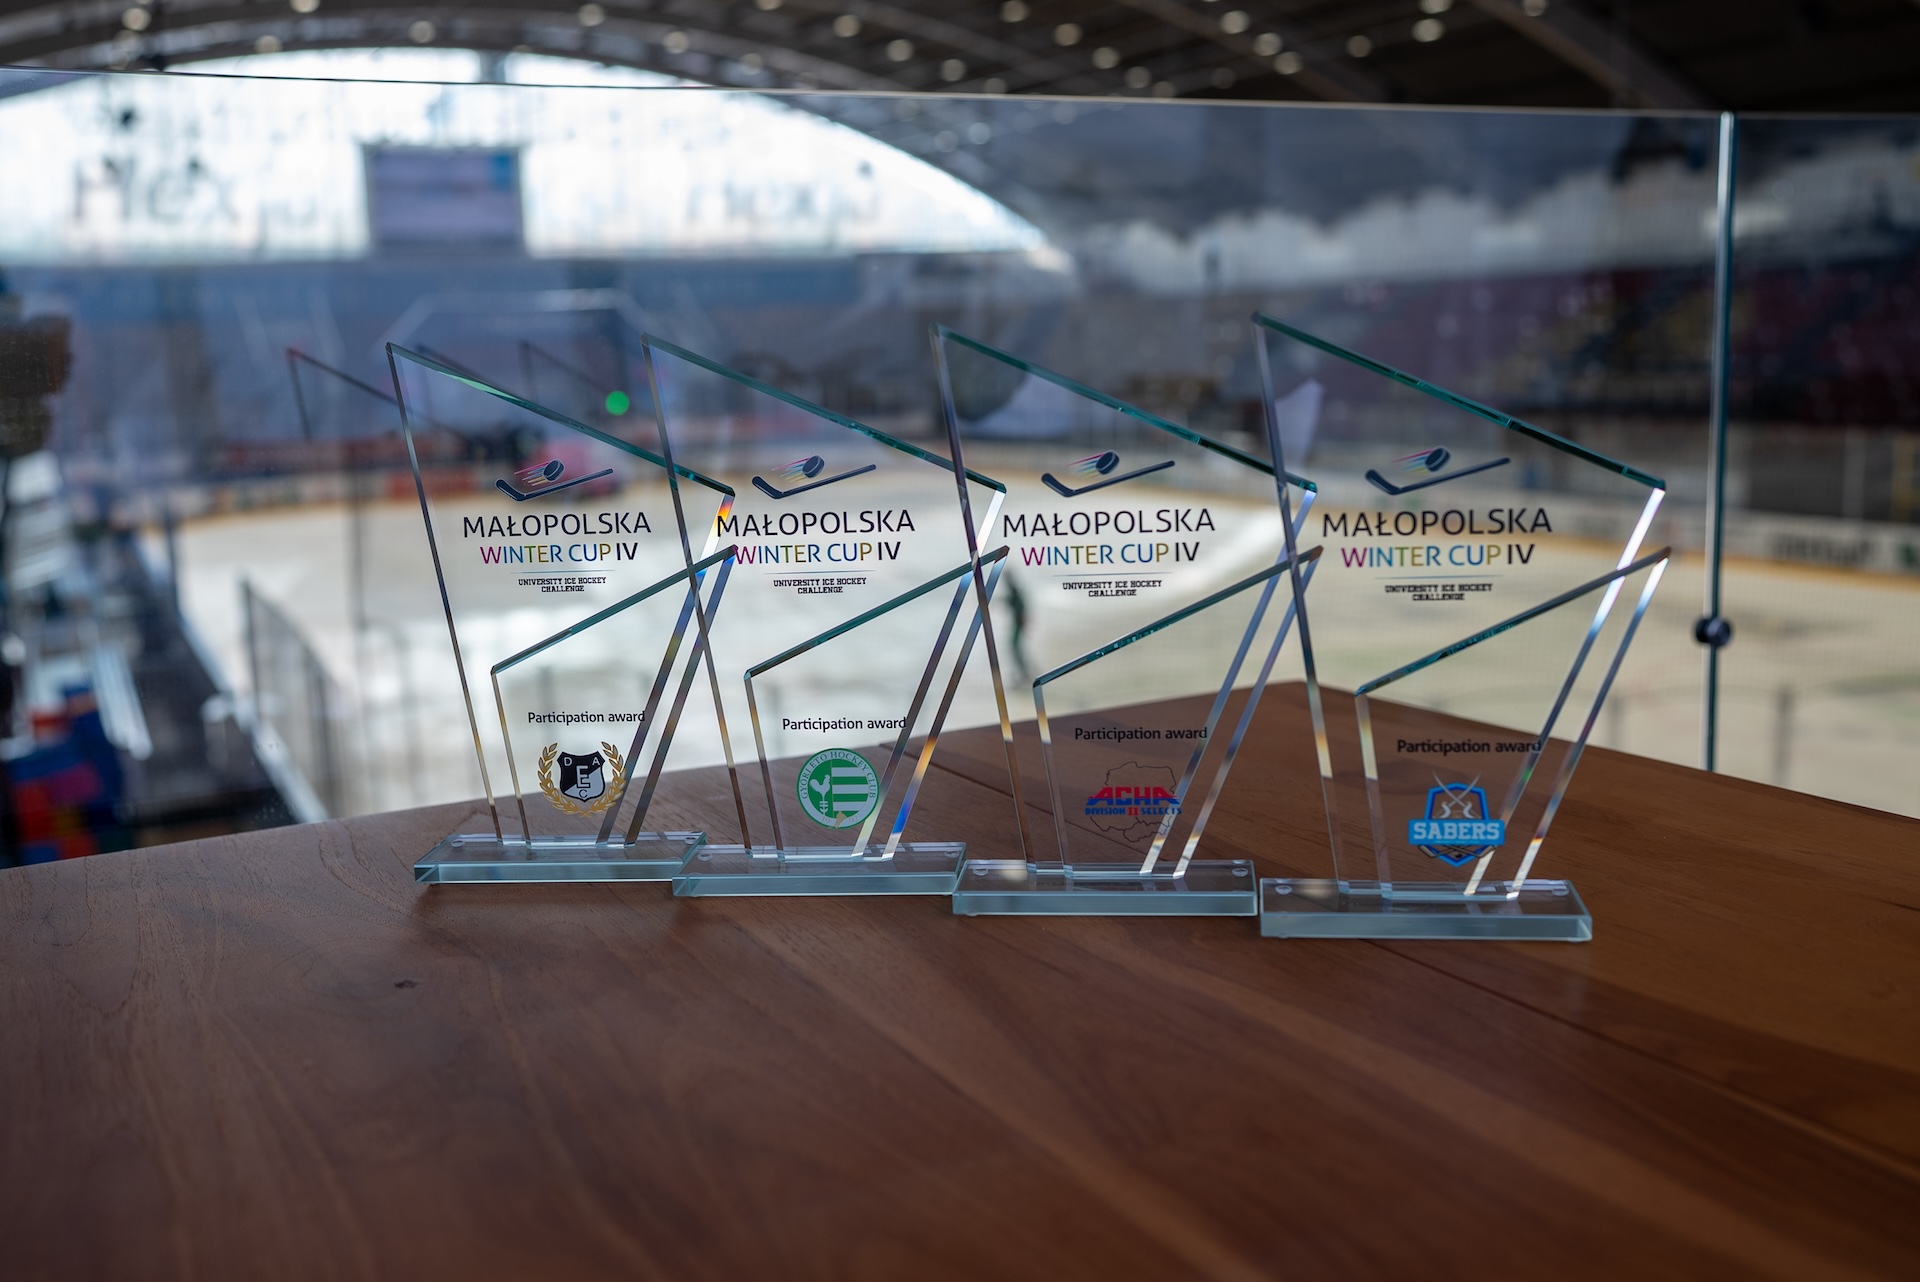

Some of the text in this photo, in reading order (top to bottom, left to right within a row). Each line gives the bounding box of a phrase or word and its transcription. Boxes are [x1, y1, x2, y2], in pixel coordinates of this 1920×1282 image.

[463, 512, 651, 537] MAŁOPOLSKA
[717, 510, 915, 537] MAŁOPOLSKA
[1004, 508, 1215, 537] MAŁOPOLSKA
[1323, 508, 1552, 537] MAŁOPOLSKA
[480, 543, 638, 564] WINTER CUP IV
[733, 542, 901, 564] WINTER CUP IV
[1021, 542, 1200, 566] WINTER CUP IV
[1341, 544, 1535, 567] WINTER CUP IV
[774, 579, 820, 587] UNIVERSITY
[1385, 585, 1439, 593] UNIVERSITY
[528, 711, 645, 726] Participation award
[782, 717, 906, 733] Participation award
[1075, 727, 1207, 743] Participation award
[1397, 740, 1542, 756] Participation award
[564, 757, 600, 766] D A
[576, 765, 591, 788] E
[810, 754, 827, 768] ETO
[831, 752, 869, 771] HOCKEY
[867, 773, 876, 798] CLUB
[579, 790, 588, 798] C
[1086, 786, 1180, 805] ACHA
[1128, 807, 1138, 816] II
[1414, 822, 1499, 840] SABERS
